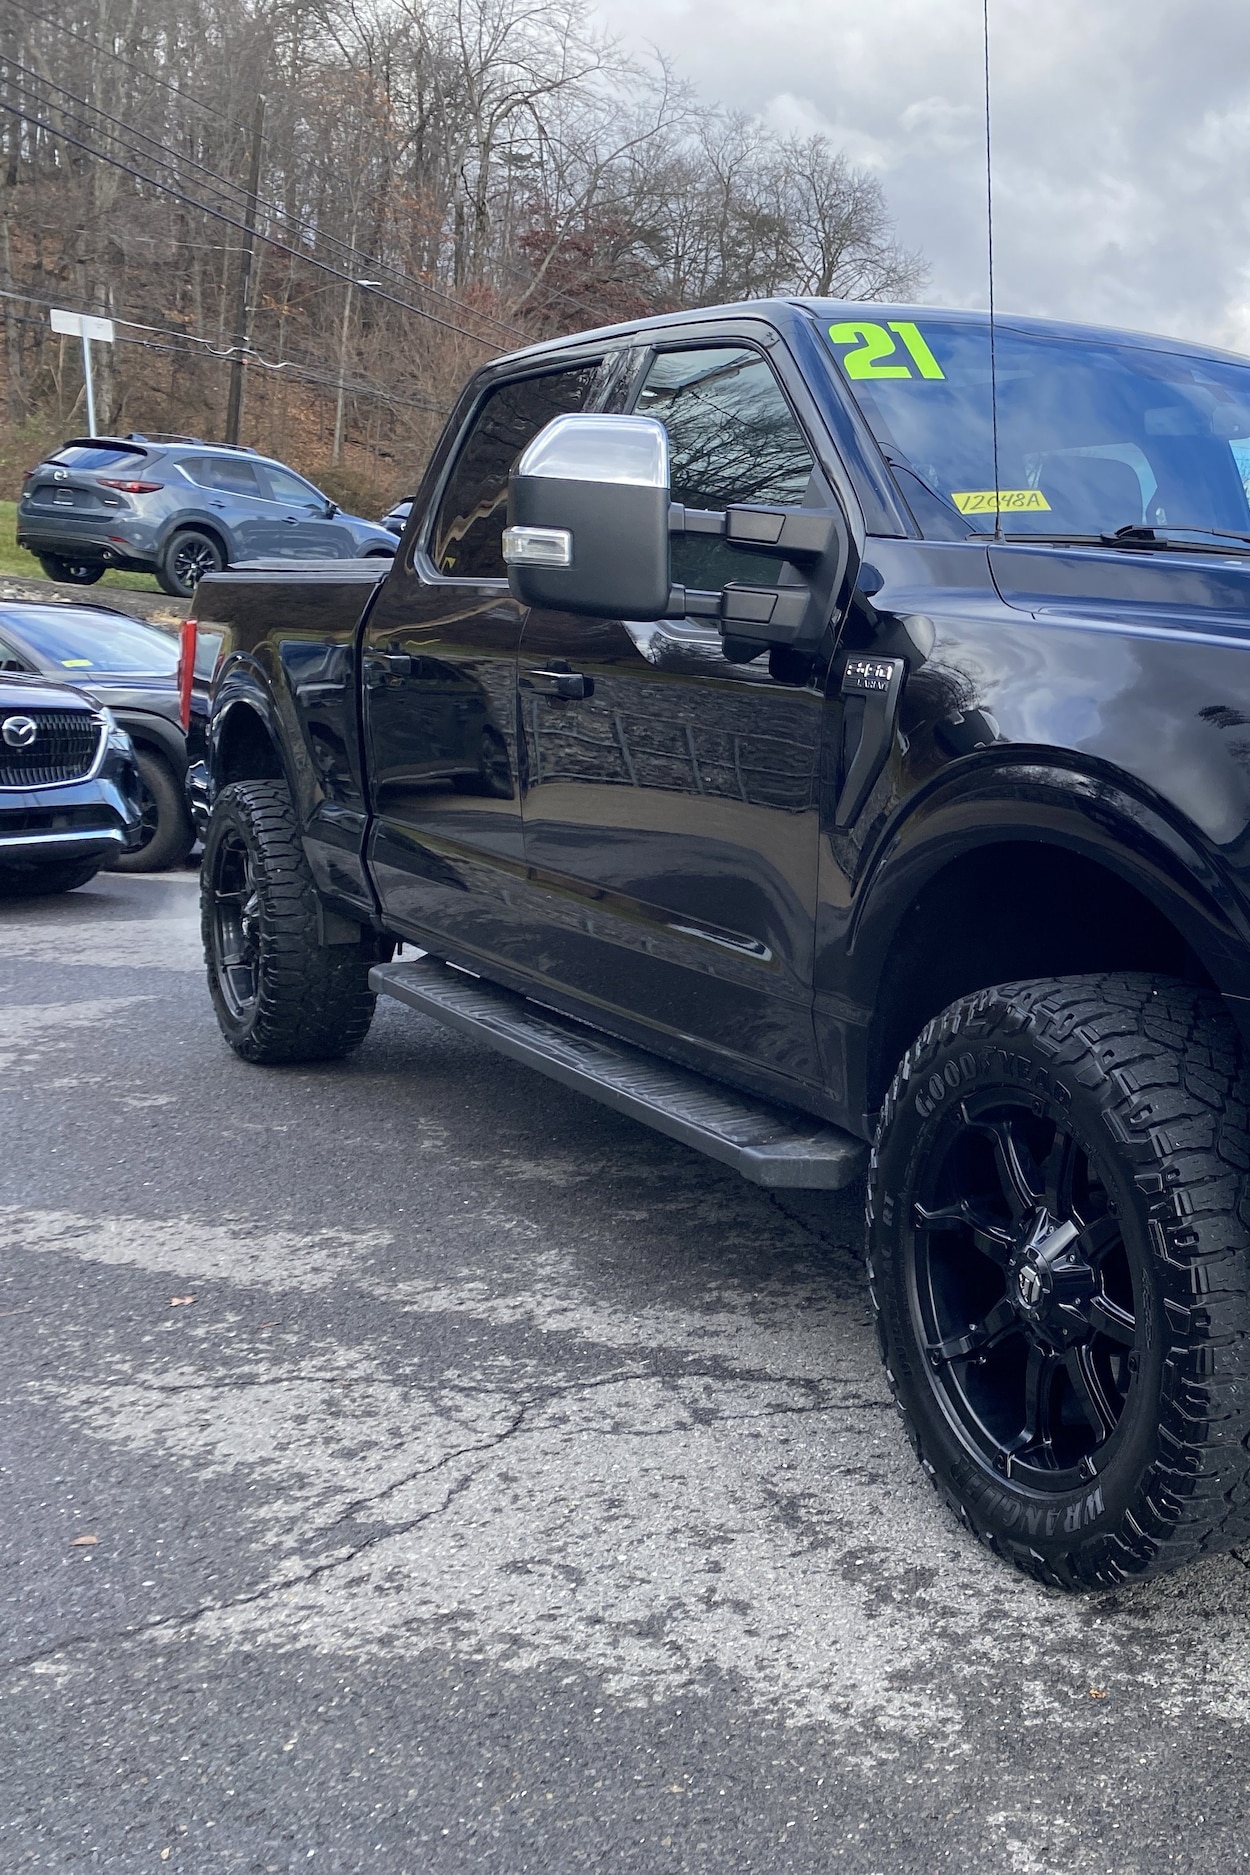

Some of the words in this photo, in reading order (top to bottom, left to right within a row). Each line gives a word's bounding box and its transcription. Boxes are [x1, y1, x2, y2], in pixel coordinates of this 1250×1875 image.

[828, 321, 946, 380] 21
[961, 493, 1040, 511] 12048A
[915, 1047, 1073, 1117] GOODYEAR
[950, 1454, 1106, 1537] WRANGLER
